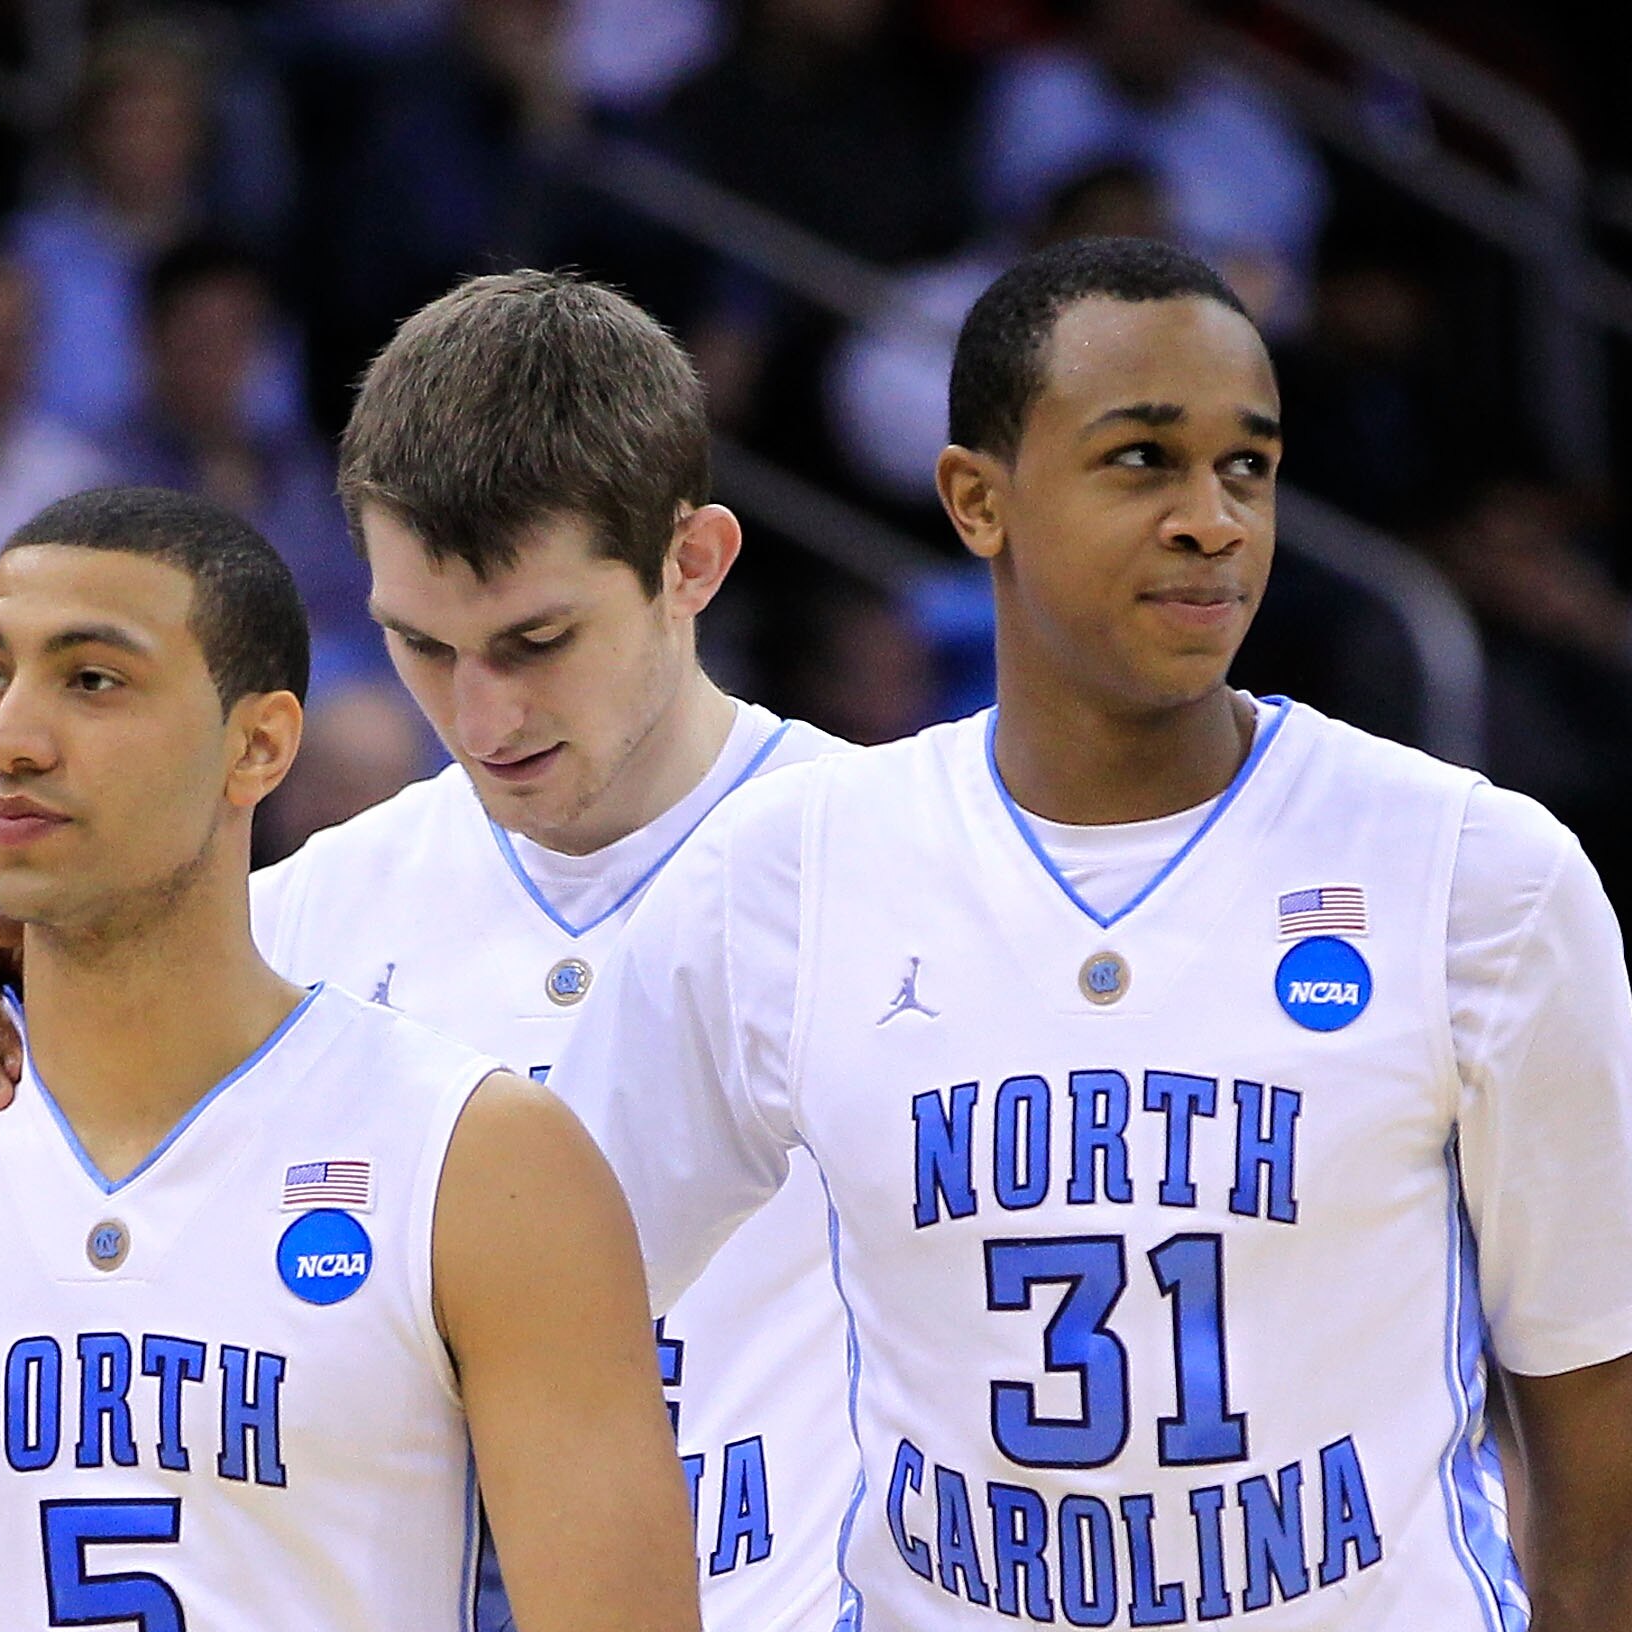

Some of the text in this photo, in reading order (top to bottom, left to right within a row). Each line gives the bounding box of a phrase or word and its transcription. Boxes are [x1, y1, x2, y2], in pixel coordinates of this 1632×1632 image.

[1287, 980, 1361, 1006] NCAA
[912, 1069, 1302, 1229] NORTH
[295, 1252, 366, 1279] NCAA
[983, 1233, 1248, 1470] 31
[887, 1435, 1382, 1628] CAROLINA
